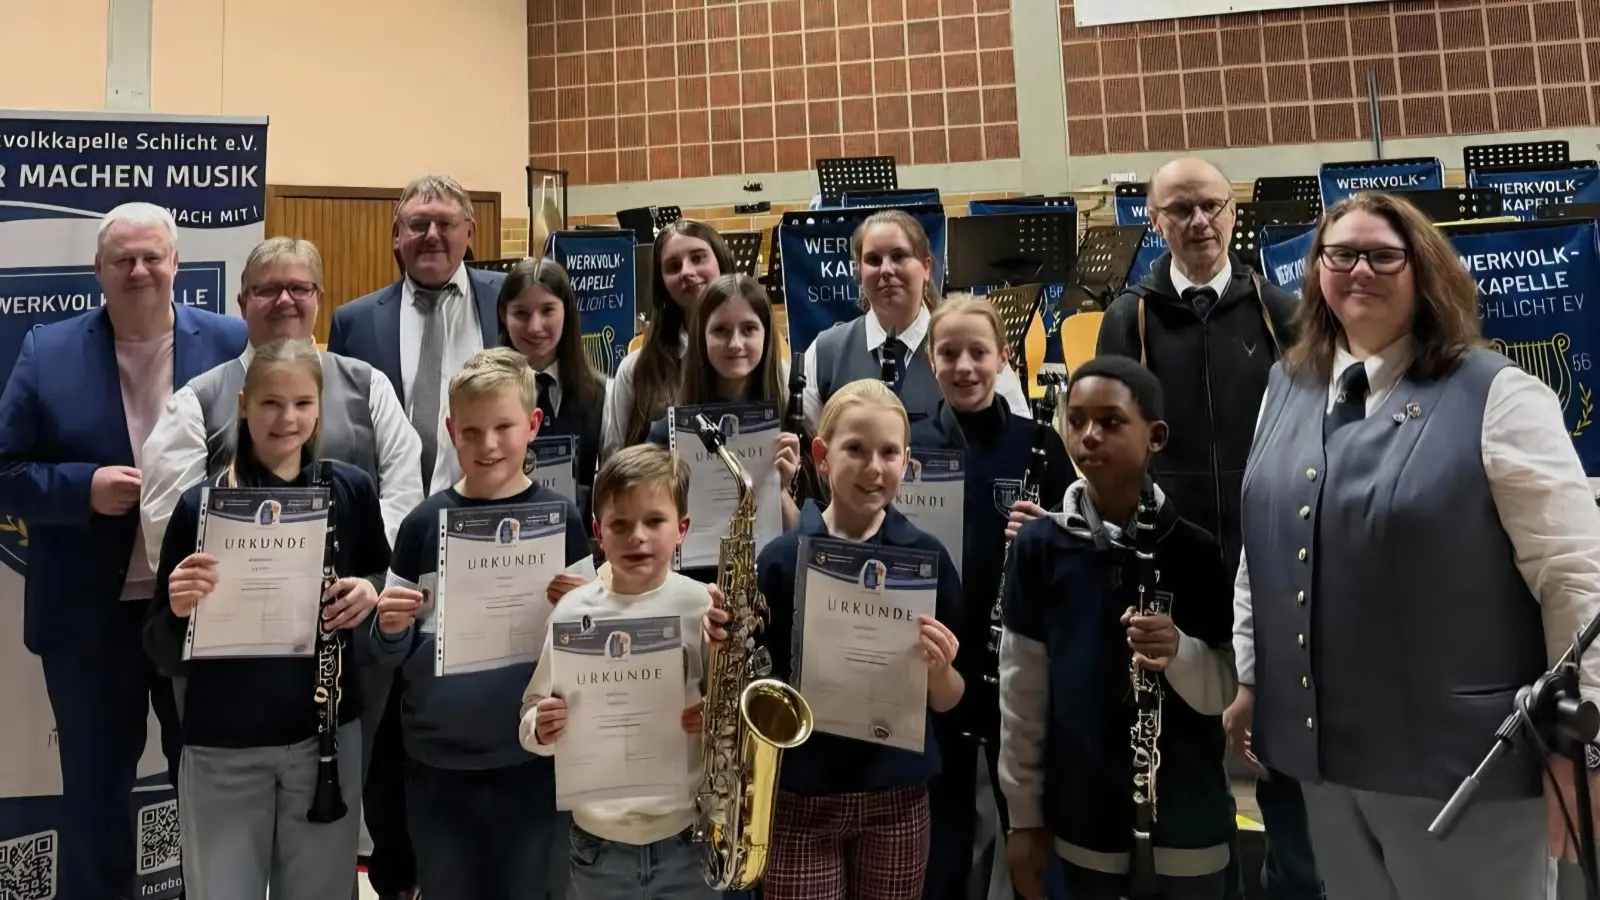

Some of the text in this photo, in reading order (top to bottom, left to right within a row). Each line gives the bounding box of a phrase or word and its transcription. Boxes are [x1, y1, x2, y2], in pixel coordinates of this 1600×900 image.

[136, 133, 217, 150] Schlicht
[225, 135, 257, 150] e.V.
[20, 164, 153, 187] MACHEN
[166, 165, 258, 187] MUSIK
[1336, 174, 1427, 189] WERKVOLK-
[220, 208, 248, 222] MIT
[1460, 246, 1580, 272] WERKVOLK-
[570, 274, 616, 291] KAPELLE
[608, 293, 624, 308] EV
[1477, 293, 1584, 319] CHLICHT EV
[1572, 353, 1592, 372] 56
[224, 537, 307, 550] URKUNDE
[468, 552, 546, 570] URKUNDE
[828, 595, 913, 622] URKUNDE
[577, 668, 665, 685] URKUNDE
